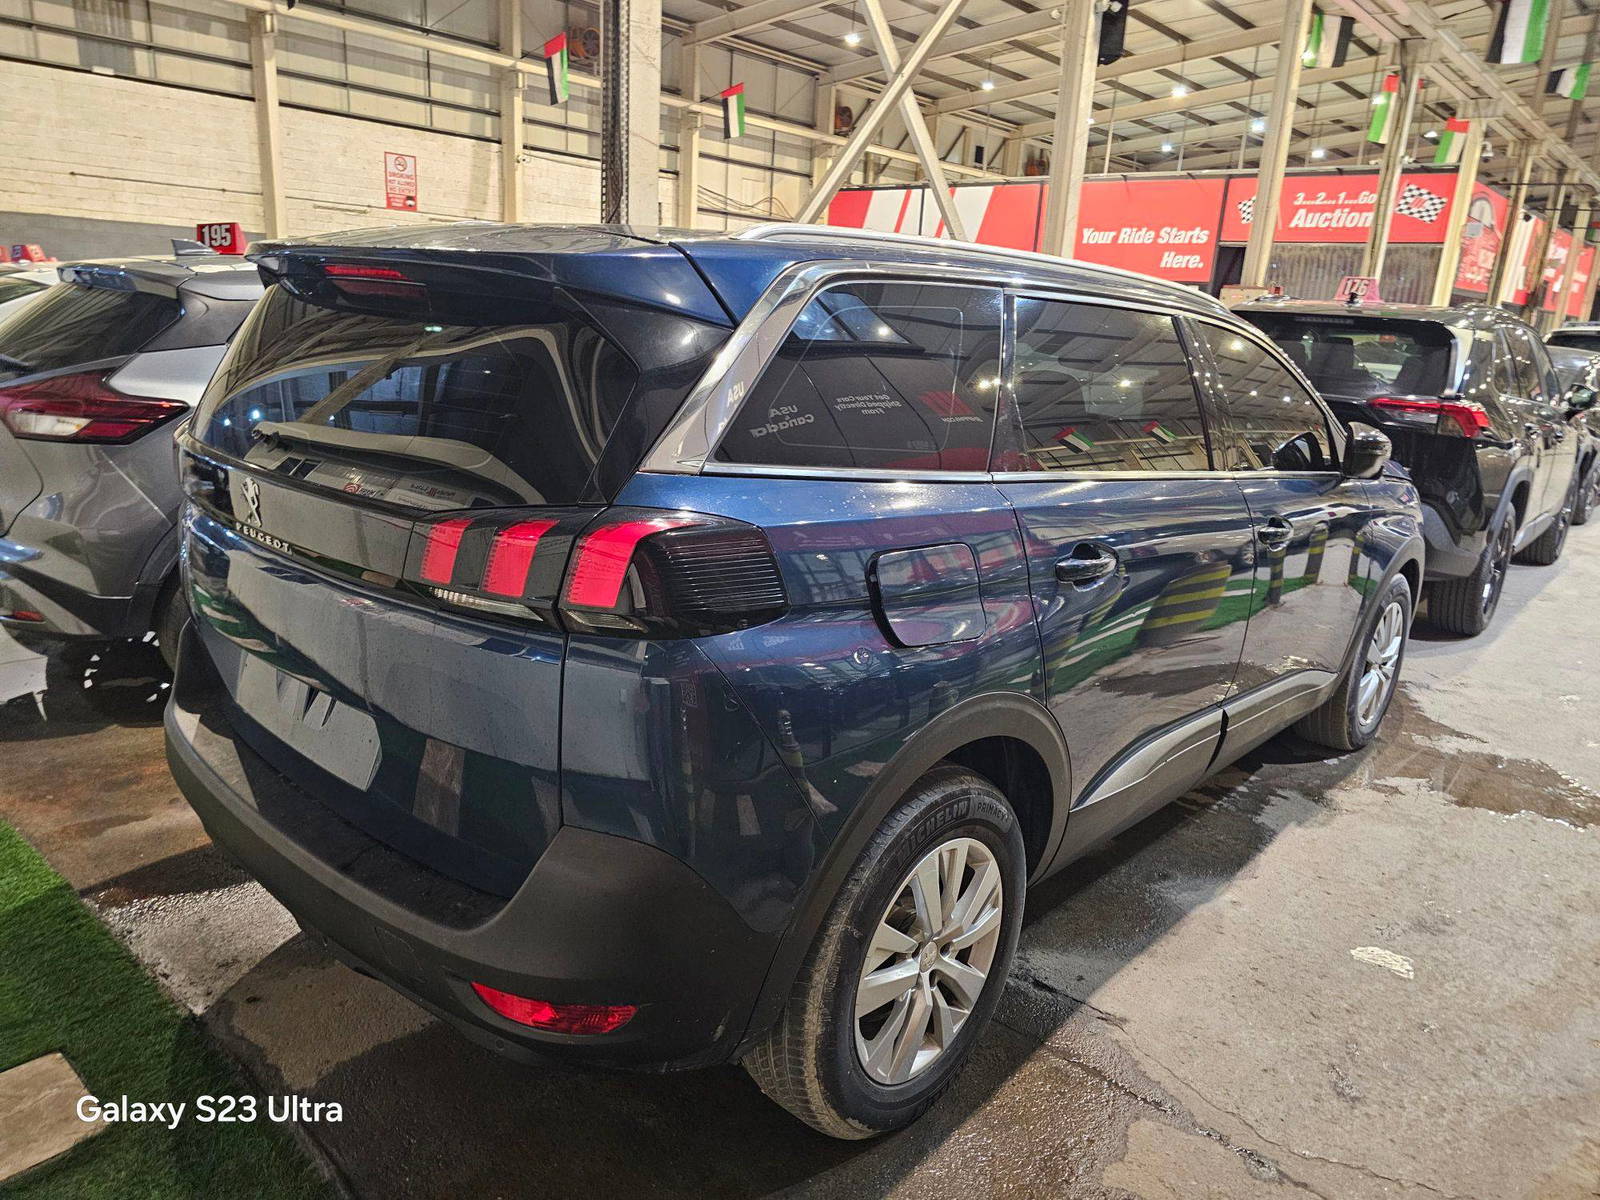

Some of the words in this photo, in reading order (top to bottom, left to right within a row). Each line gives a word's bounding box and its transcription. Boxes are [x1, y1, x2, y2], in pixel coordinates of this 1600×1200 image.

[1289, 208, 1376, 228] Auction
[202, 224, 232, 247] 195
[1082, 228, 1117, 244] Your
[1117, 227, 1155, 244] Ride
[1157, 227, 1210, 244] Starts
[1160, 252, 1204, 269] Here.
[1344, 279, 1370, 296] 176
[235, 521, 289, 553] PEUGEOT
